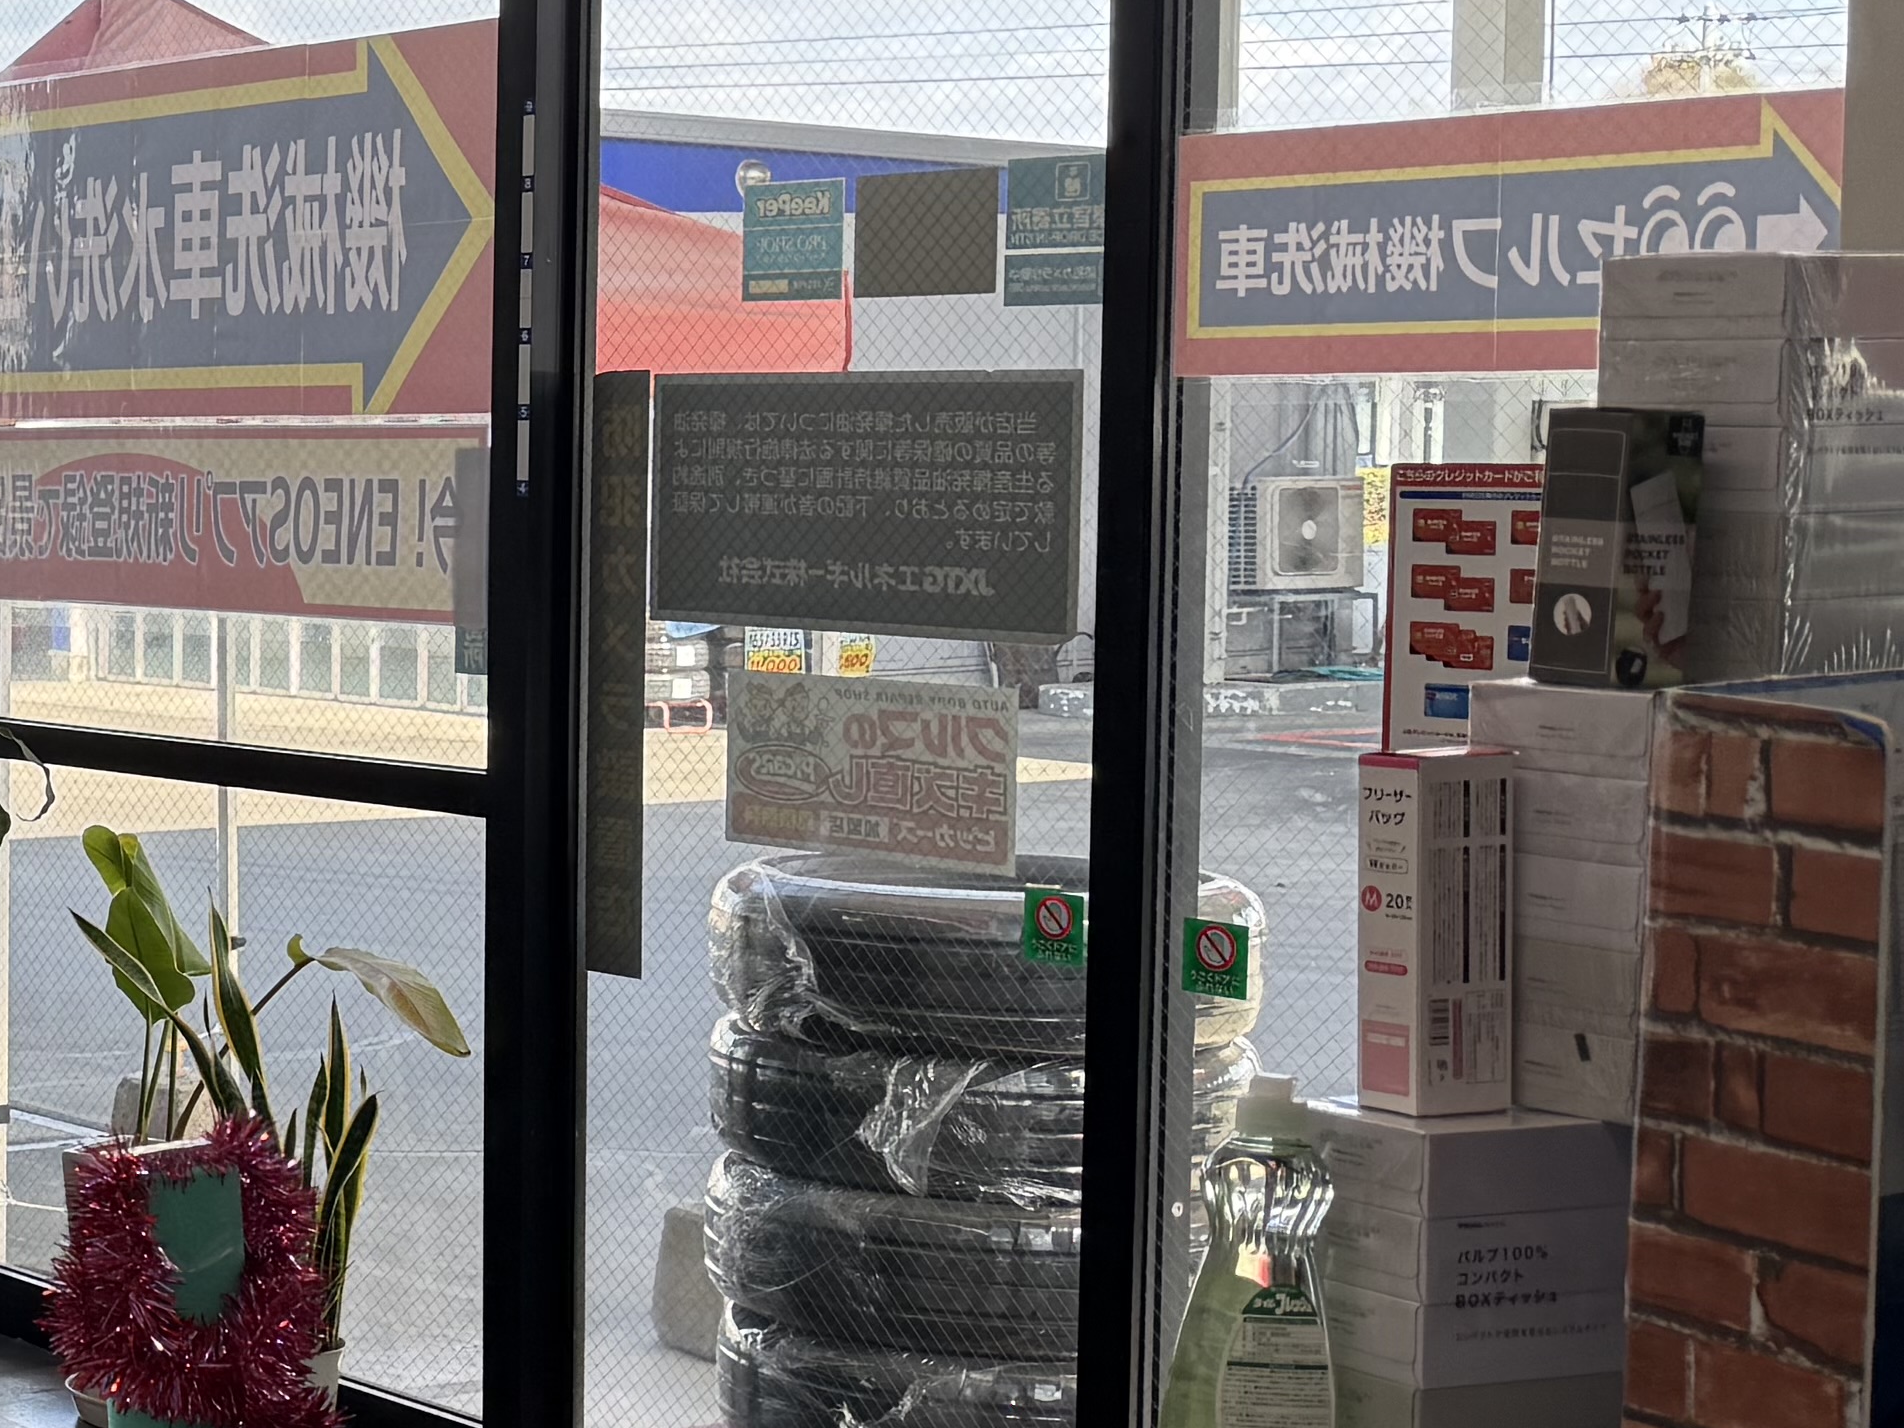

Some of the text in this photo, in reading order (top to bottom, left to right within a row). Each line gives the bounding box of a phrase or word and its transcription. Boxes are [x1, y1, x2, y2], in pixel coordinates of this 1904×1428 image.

[1362, 787, 1413, 802] フリーザー
[1368, 810, 1406, 826] バッグ
[1365, 890, 1379, 906] M
[1457, 1244, 1550, 1265] パルプ100%
[1456, 1267, 1525, 1285] コンパクト
